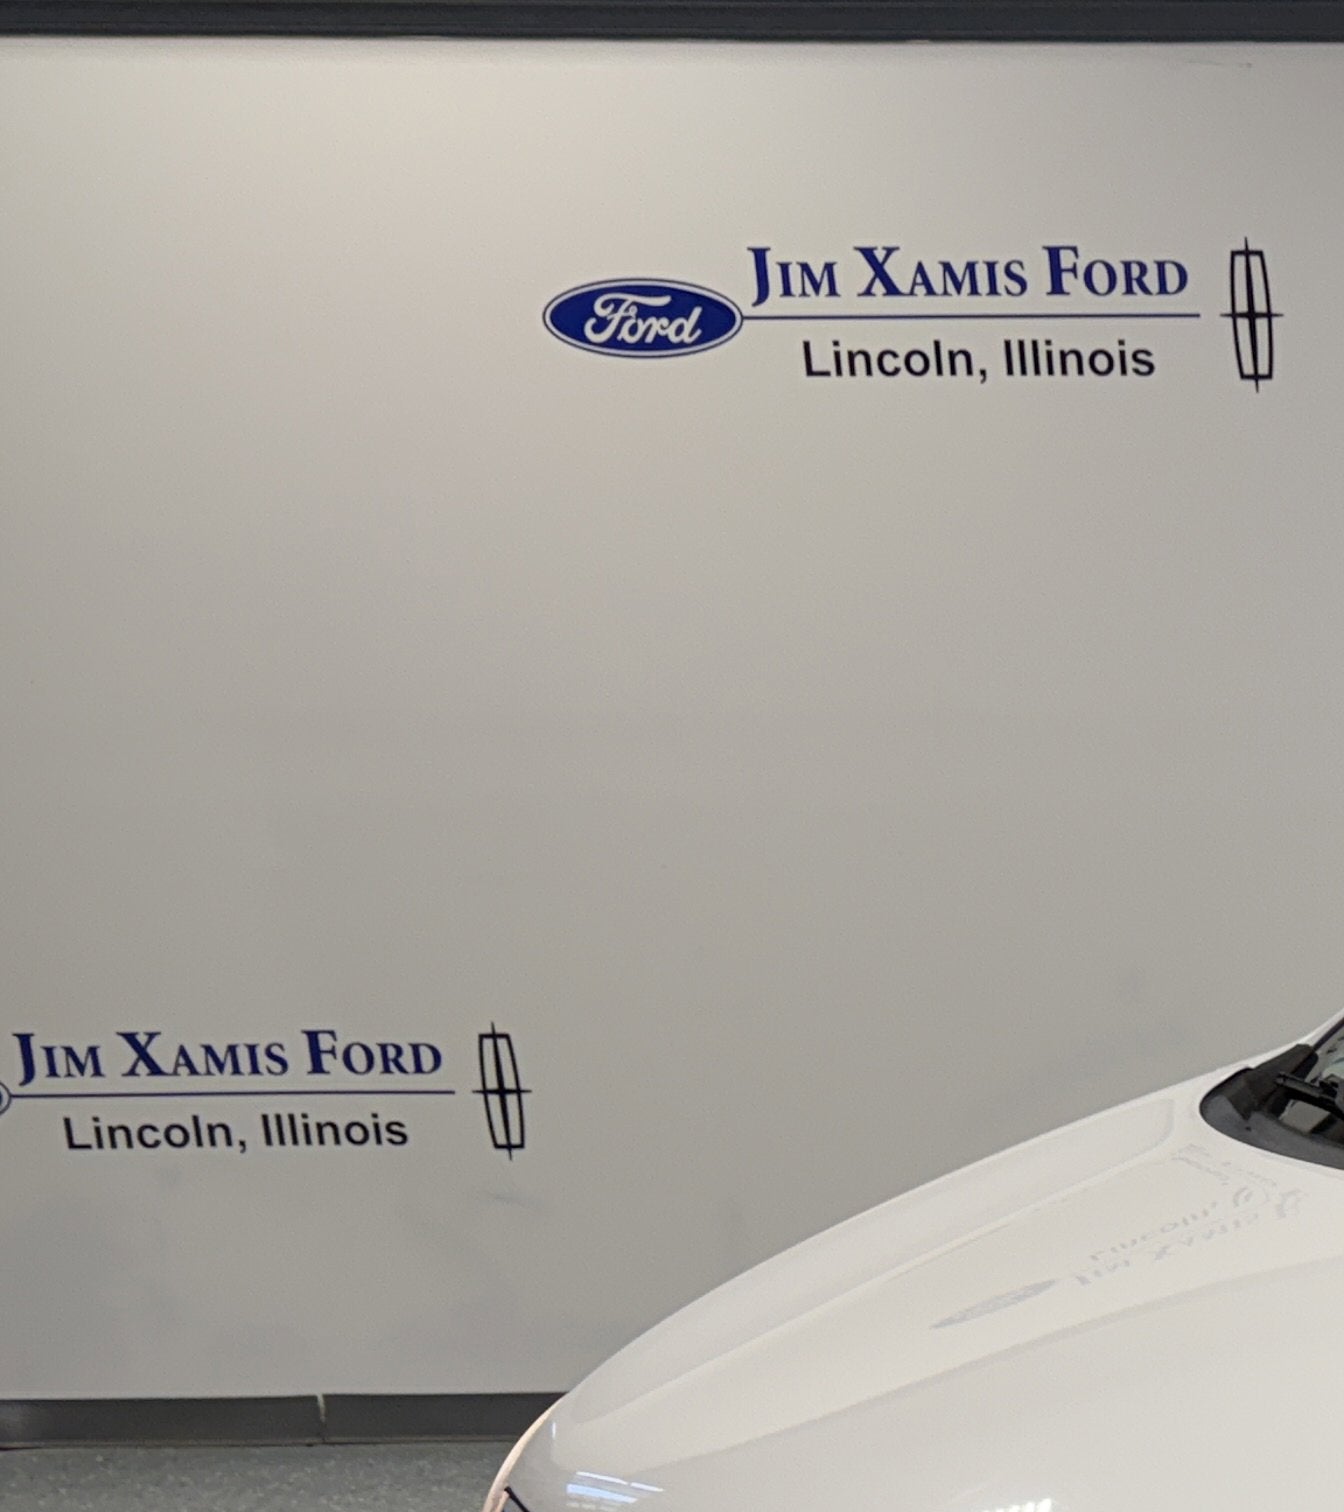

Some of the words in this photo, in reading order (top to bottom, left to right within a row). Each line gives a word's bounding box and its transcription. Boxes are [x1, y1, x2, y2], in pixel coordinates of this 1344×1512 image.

[747, 246, 838, 307] JIM
[853, 246, 1028, 298] XAMIS
[1042, 245, 1189, 297] FORD
[584, 291, 703, 345] Ford
[802, 340, 988, 384] Lincoln,
[1004, 339, 1156, 378] Illinois
[11, 1032, 107, 1087] JIM
[115, 1031, 290, 1077] XAMIS
[301, 1029, 443, 1075] FORD
[63, 1114, 247, 1153] Lincoln,
[261, 1112, 409, 1148] Illinois
